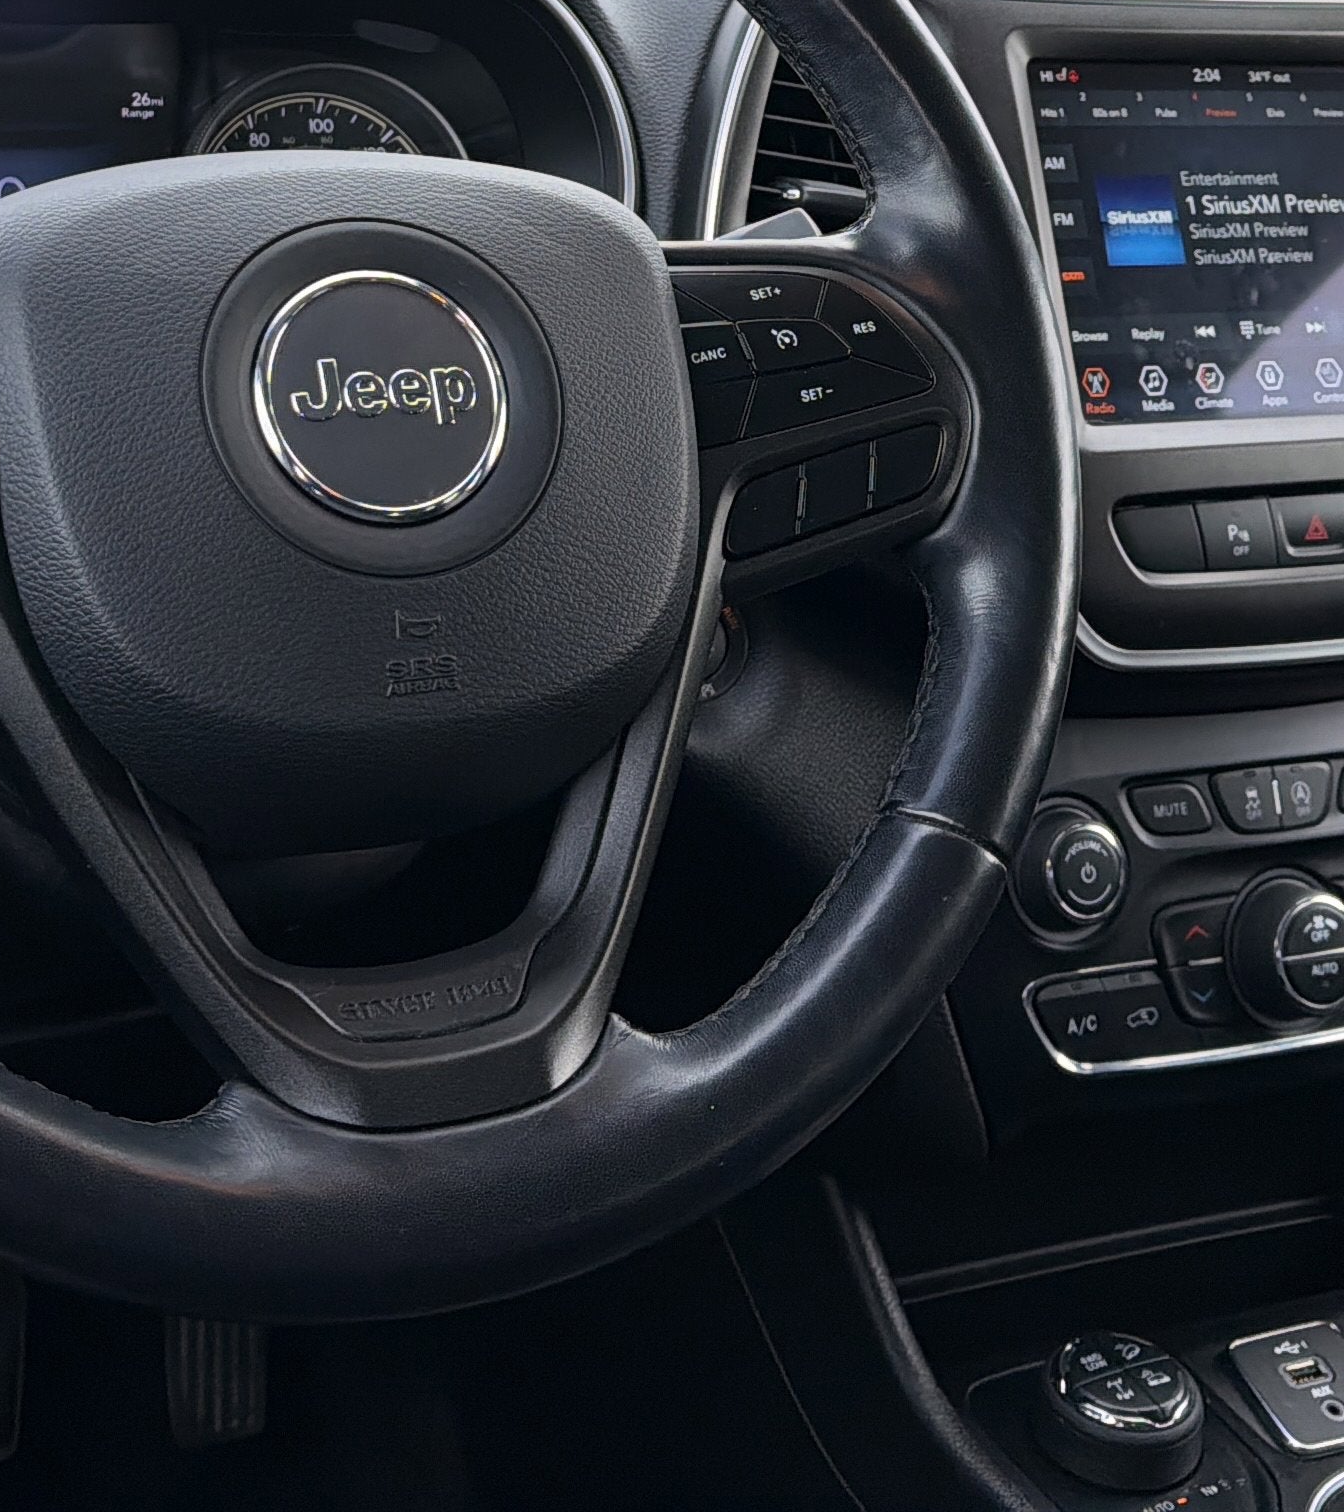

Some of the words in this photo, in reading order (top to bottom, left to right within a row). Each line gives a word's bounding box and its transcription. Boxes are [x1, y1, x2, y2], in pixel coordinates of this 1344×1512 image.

[1192, 68, 1222, 83] 2:04
[121, 107, 155, 120] Range
[308, 118, 334, 134] 100
[249, 132, 271, 148] 80
[1044, 156, 1066, 170] AM
[1180, 170, 1280, 187] Entertainment
[1185, 196, 1197, 215] 1
[1201, 194, 1282, 216] SiriusXM
[1053, 213, 1075, 227] FM
[1107, 210, 1174, 225] SiriusXM
[1189, 222, 1252, 240] SiriusXM
[1253, 221, 1309, 238] Preview
[1193, 248, 1256, 266] SiriusXM
[1258, 247, 1314, 264] Preview
[749, 286, 782, 302] SET+
[852, 320, 877, 335] RES
[1131, 327, 1165, 342] Replay
[1256, 323, 1281, 336] Tune
[1072, 330, 1109, 342] Browse
[691, 347, 727, 364] CANC
[291, 357, 478, 426] Jeep
[1085, 402, 1116, 414] Radio
[1142, 399, 1175, 412] Media
[1195, 396, 1234, 410] Climate
[1262, 395, 1288, 407] Apps
[1233, 546, 1249, 556] OFF
[385, 653, 459, 678] SRS
[385, 676, 462, 698] AIRBAG
[1153, 801, 1189, 818] MUTE
[1310, 929, 1331, 943] OFF
[1311, 961, 1339, 976] AUTO
[1067, 1014, 1098, 1037] A/C
[1311, 1384, 1335, 1399] AUX
